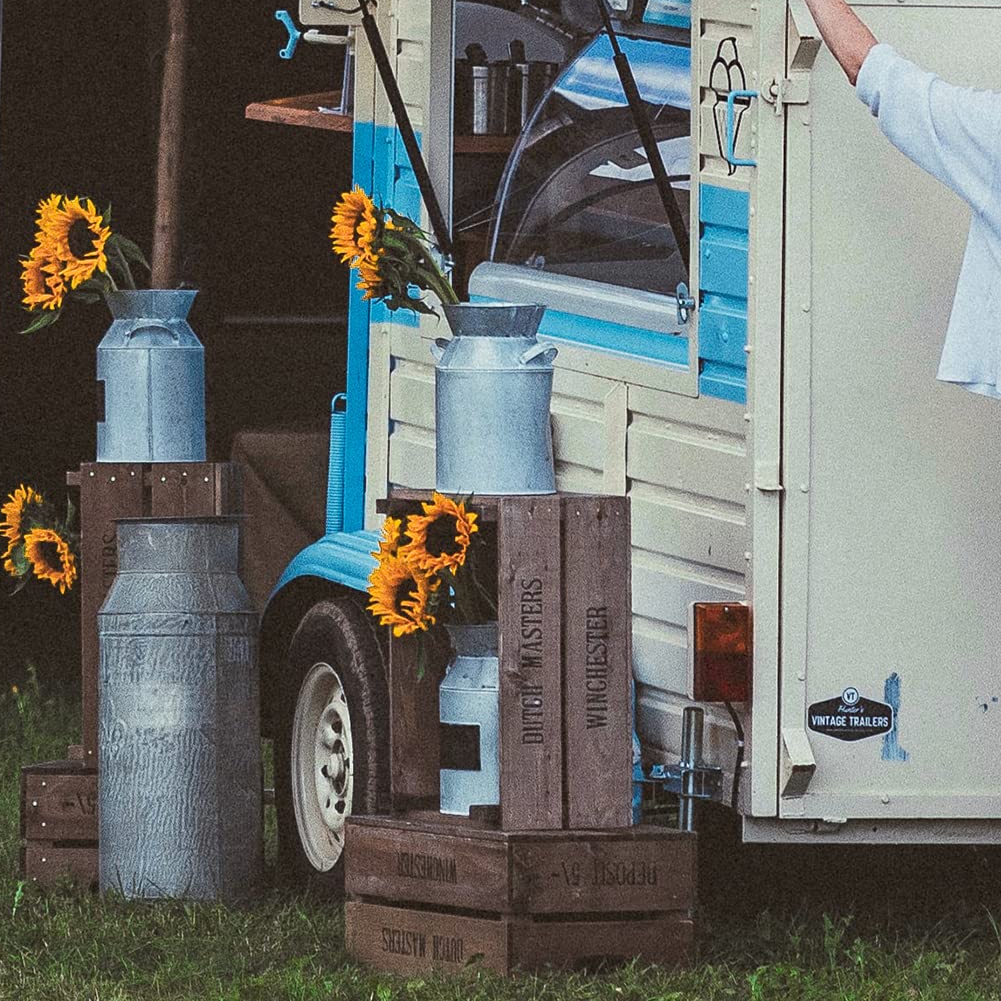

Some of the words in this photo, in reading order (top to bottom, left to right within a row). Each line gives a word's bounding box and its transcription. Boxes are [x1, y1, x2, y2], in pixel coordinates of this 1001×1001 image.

[521, 577, 543, 669] MASTERS
[586, 606, 608, 731] WINCHESTER
[521, 685, 544, 746] DUTCH
[811, 715, 847, 727] VINTAGE
[849, 715, 889, 728] TRAILERS
[398, 851, 457, 885] WINCHESTER
[382, 927, 427, 958] MASTERS
[432, 934, 464, 963] DUTCH
